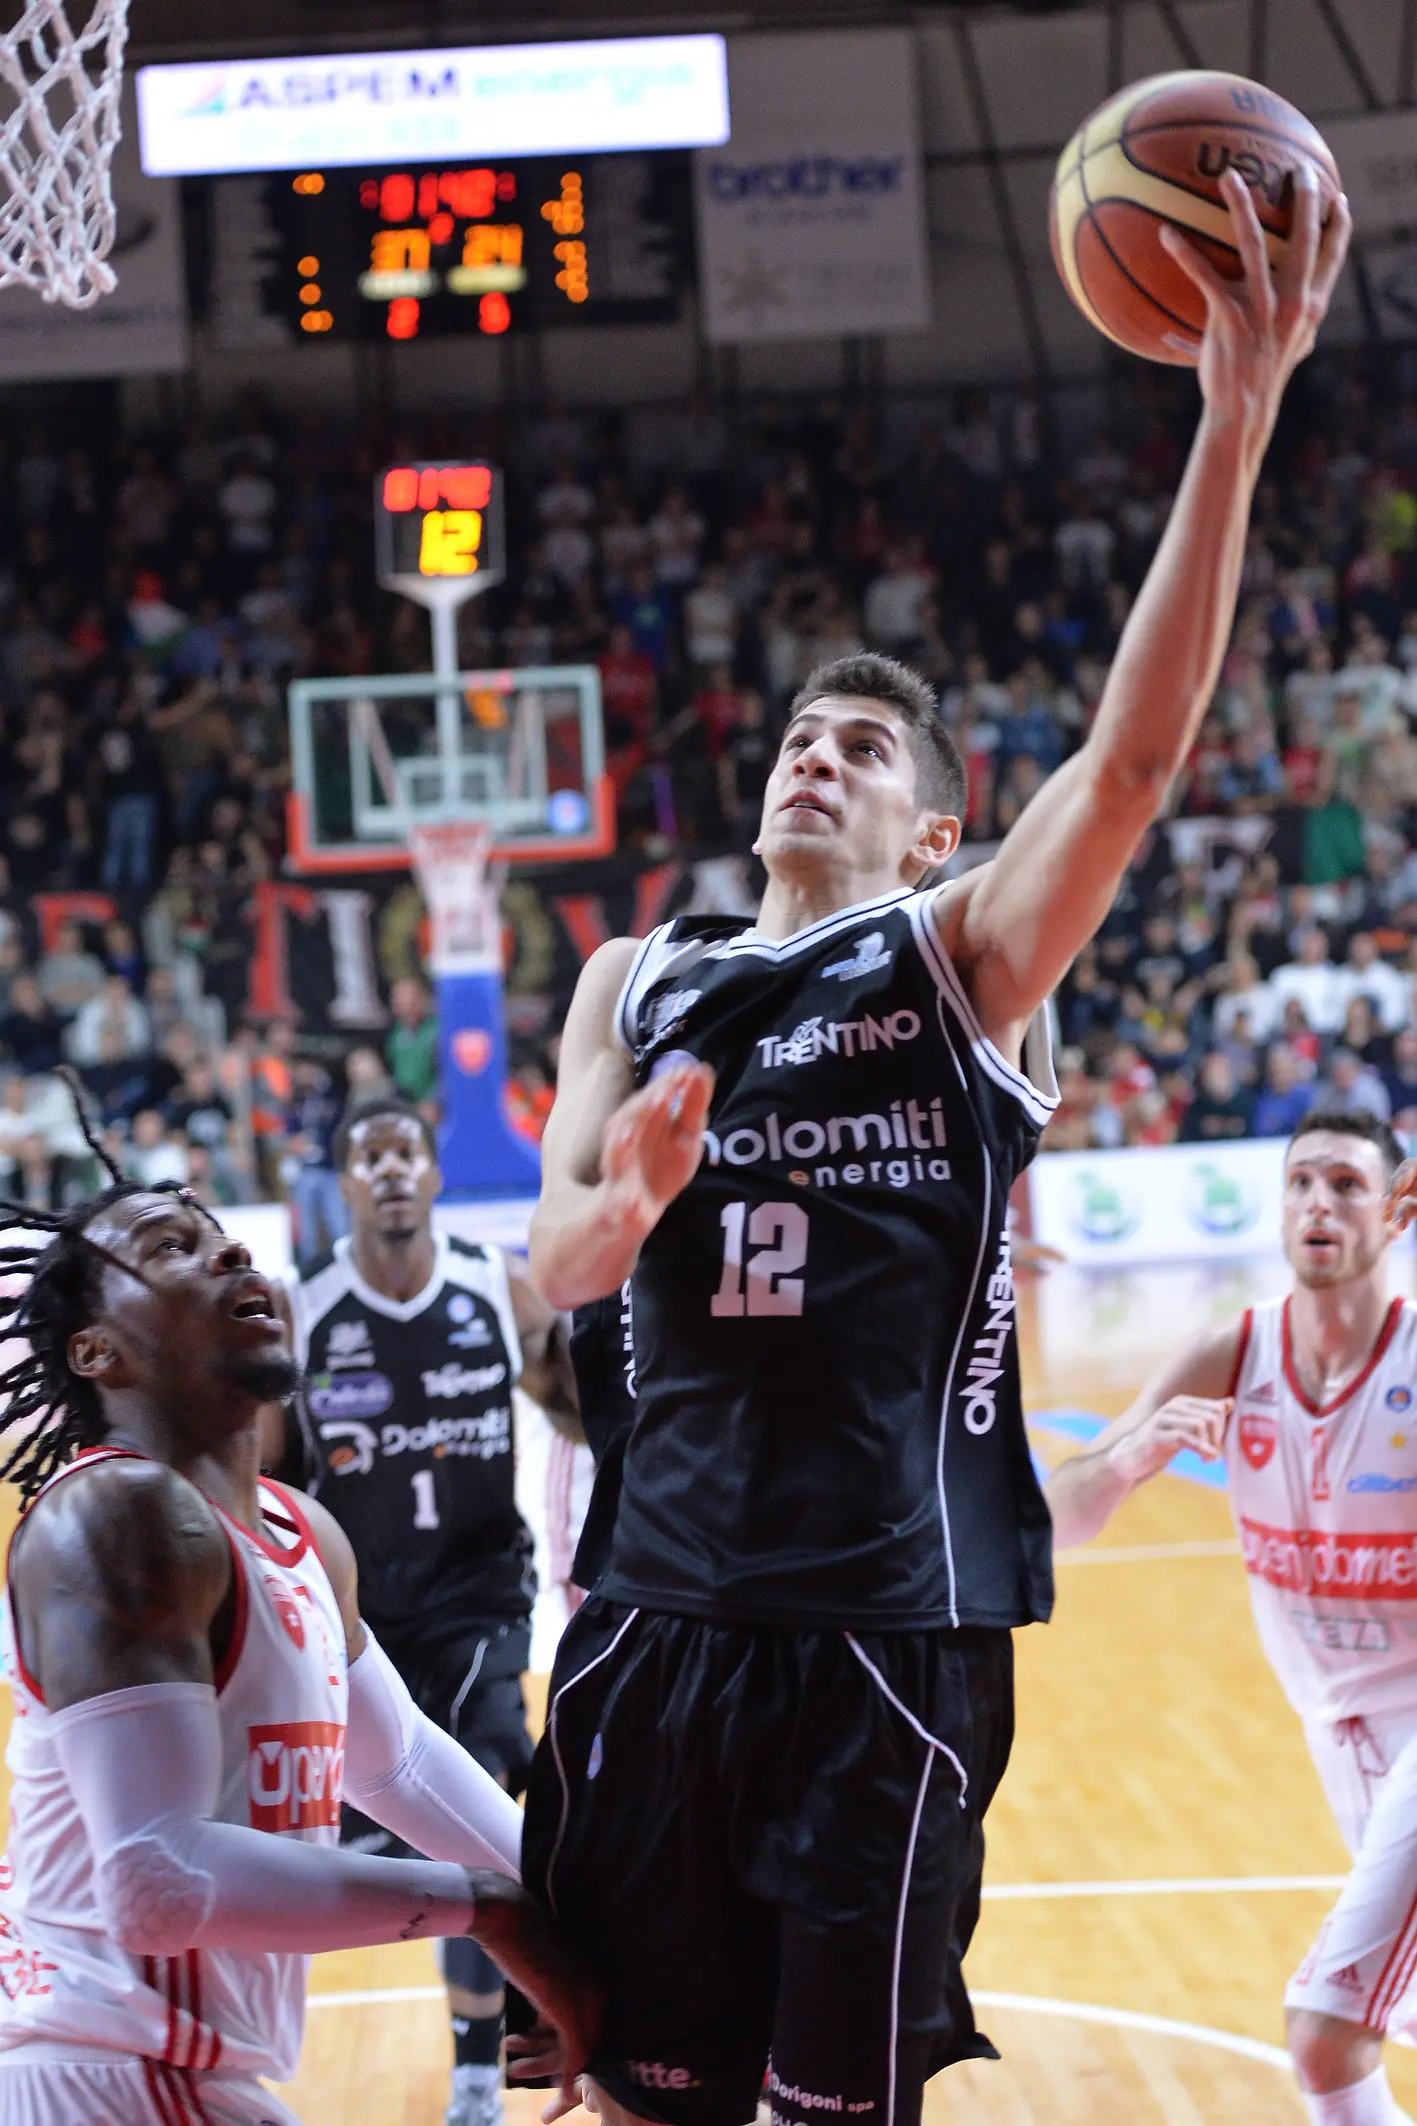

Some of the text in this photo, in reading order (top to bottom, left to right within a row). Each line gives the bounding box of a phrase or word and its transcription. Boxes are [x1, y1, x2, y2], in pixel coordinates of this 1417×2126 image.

[237, 67, 461, 109] ASPEM
[419, 510, 482, 576] 12
[756, 1009, 922, 1069] TRENTINO
[788, 1155, 952, 1188] energia
[710, 1201, 809, 1317] 12
[411, 1470, 440, 1530] 1
